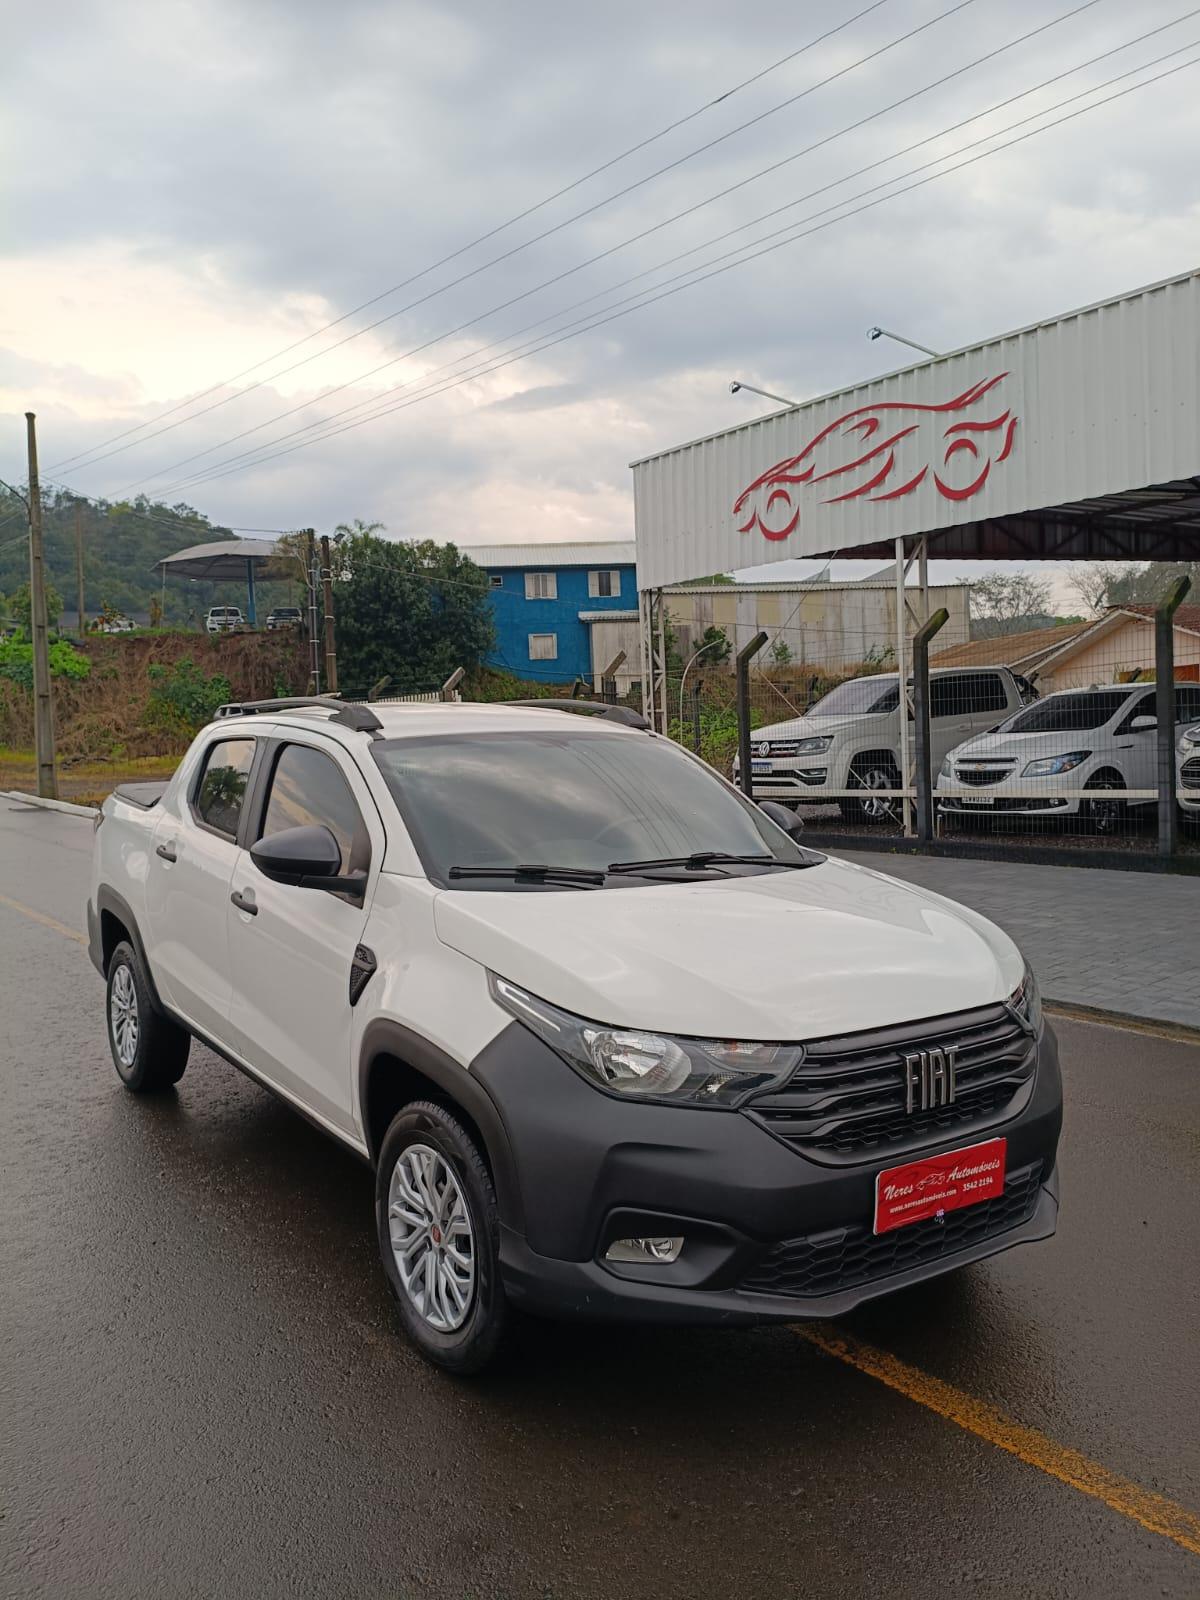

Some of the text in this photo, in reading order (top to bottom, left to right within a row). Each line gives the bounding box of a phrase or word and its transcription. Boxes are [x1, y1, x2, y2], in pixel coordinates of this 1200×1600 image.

[906, 1045, 959, 1114] FIAT
[884, 1159, 1000, 1200] Neres Automóveis
[962, 1182, 979, 1192] 3542
